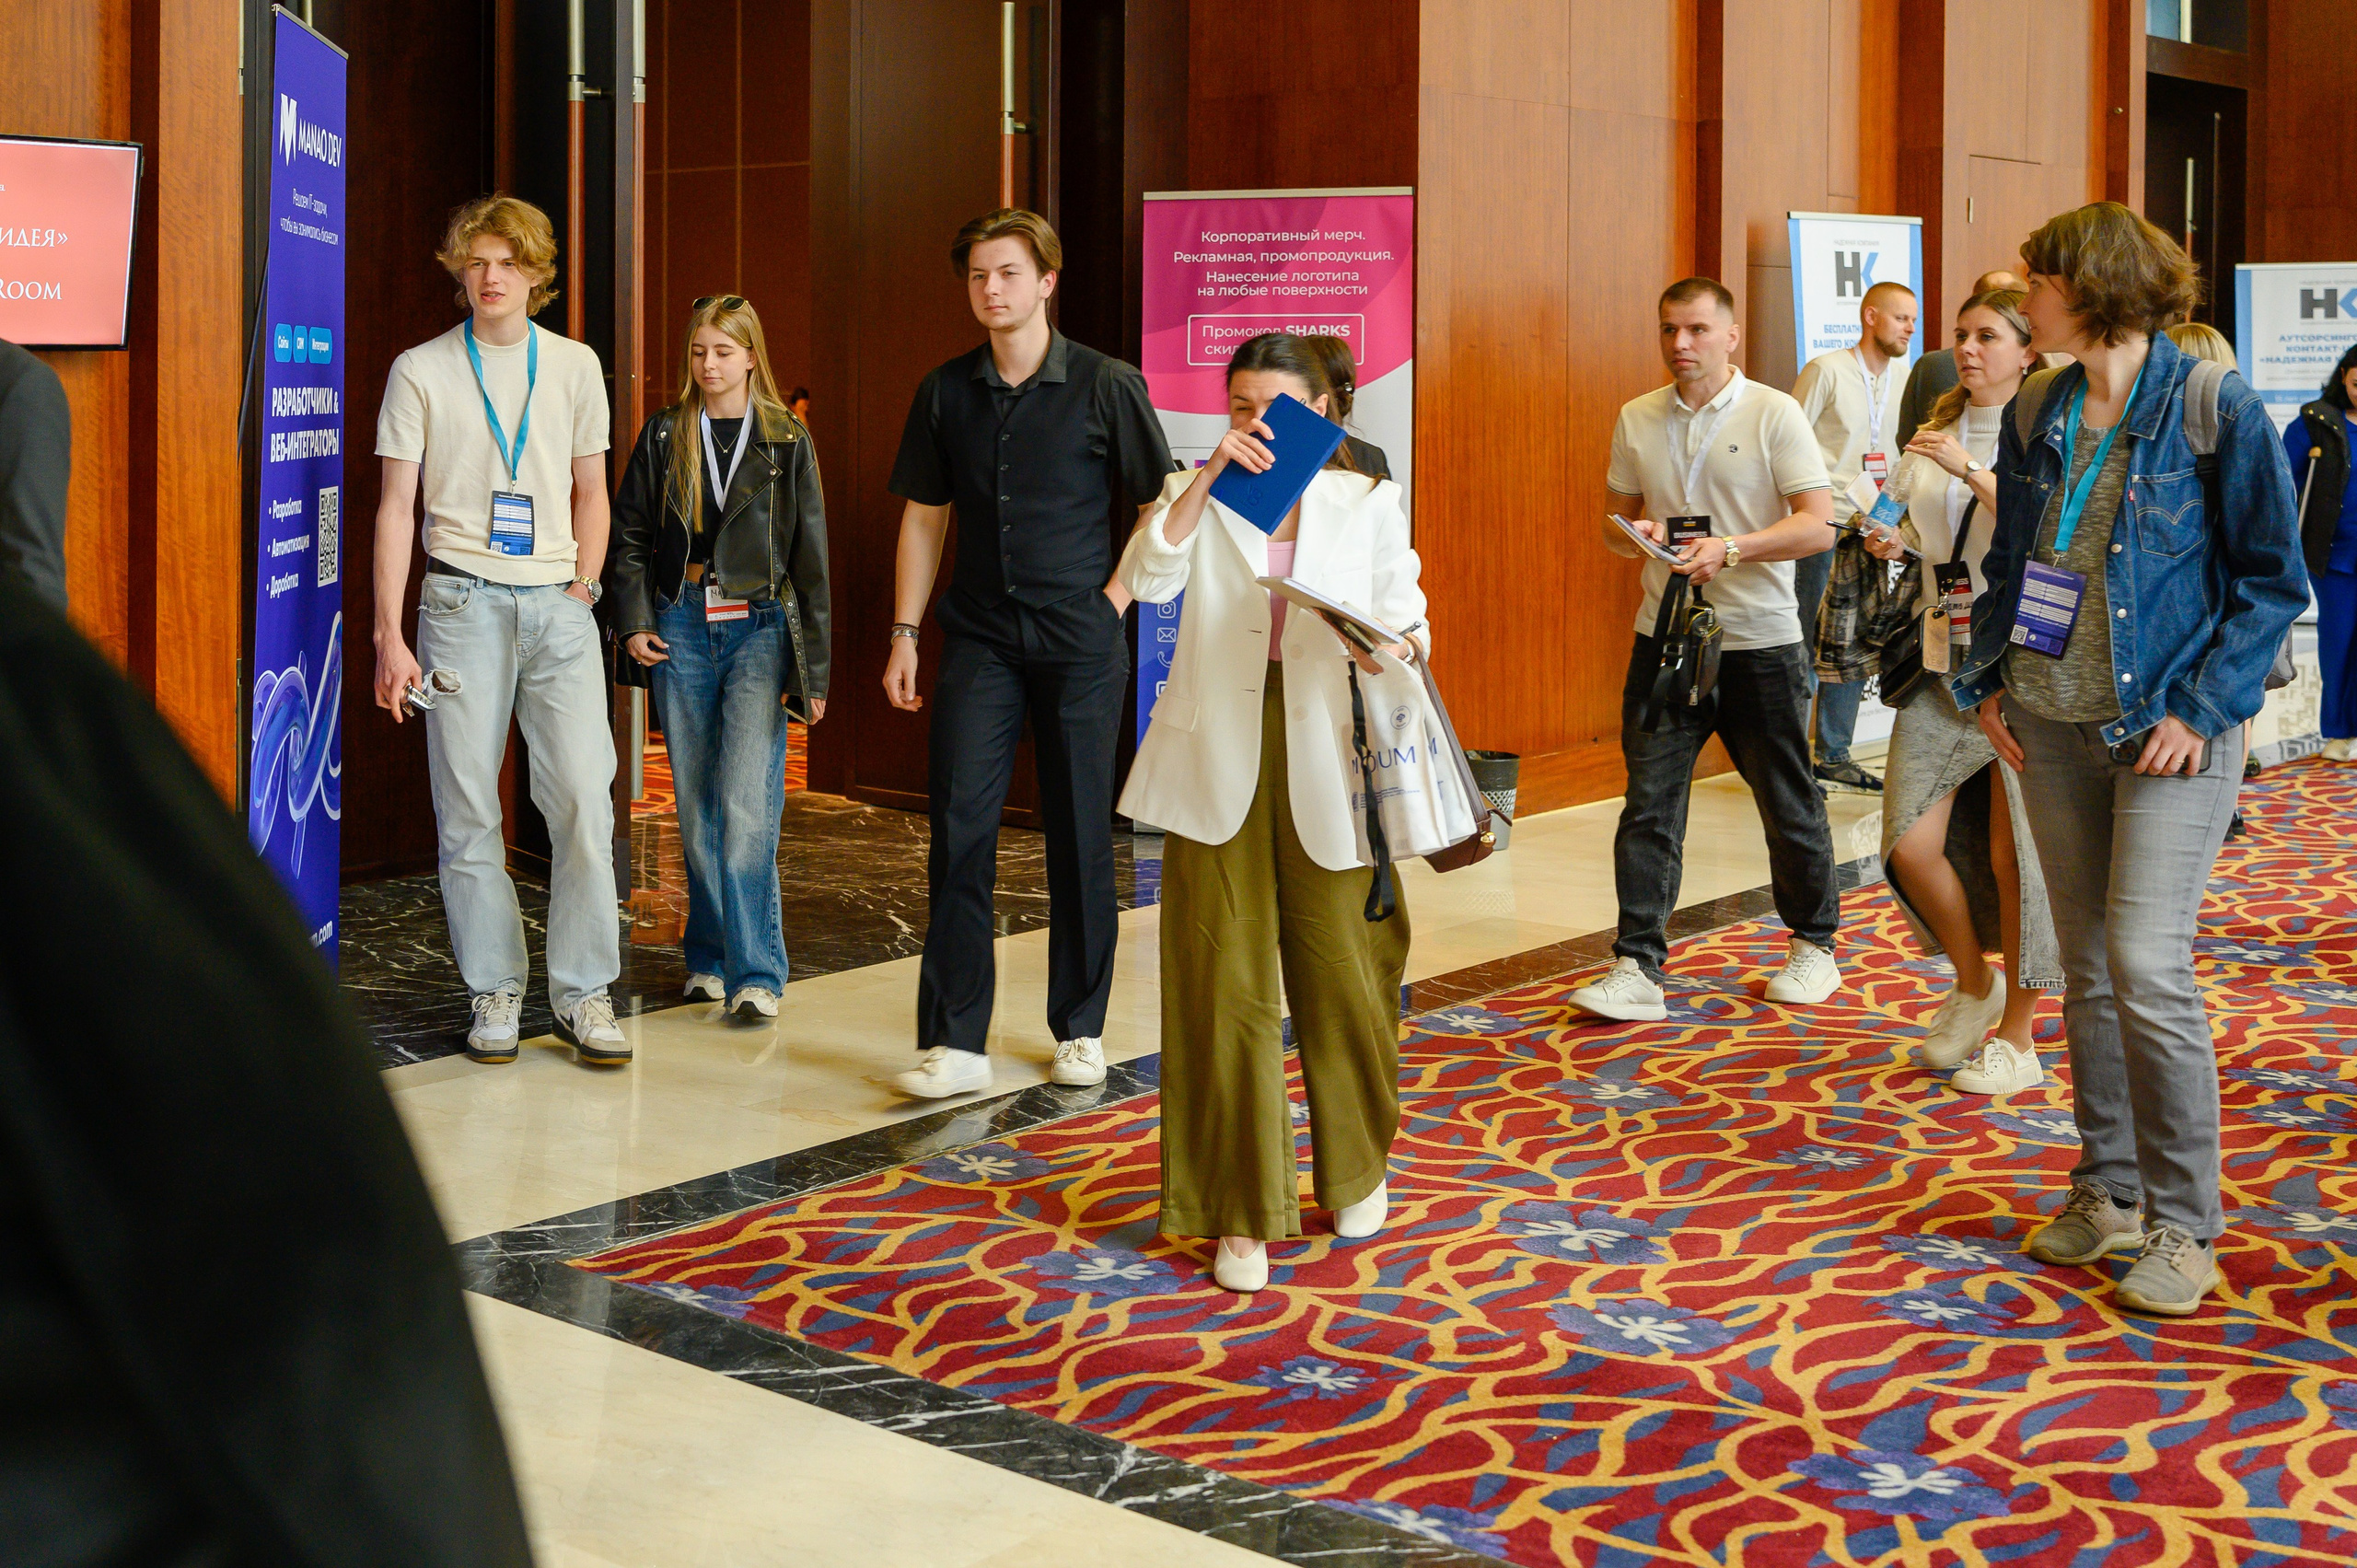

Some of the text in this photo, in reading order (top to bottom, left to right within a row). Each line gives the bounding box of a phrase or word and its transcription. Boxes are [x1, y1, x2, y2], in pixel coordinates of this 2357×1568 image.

[298, 117, 328, 162] MANAO
[328, 132, 342, 168] DEV
[1201, 229, 1366, 245] Корпоративный мерч.
[1173, 250, 1395, 264] Рекламная, промопродукция.
[1206, 271, 1360, 283] Нанесение логотипа
[1197, 284, 1368, 298] на любые поверхности
[1285, 324, 1351, 337] SHARKS
[1813, 339, 1842, 349] ВАШЕГО
[272, 387, 340, 417] РАЗРАБОТЧИКИ &
[270, 428, 340, 463] ВЕБ-ИНТЕГРАТОРЫ
[273, 497, 302, 523] Разработка
[272, 534, 310, 558] Автоматизация
[270, 572, 299, 599] Доработка
